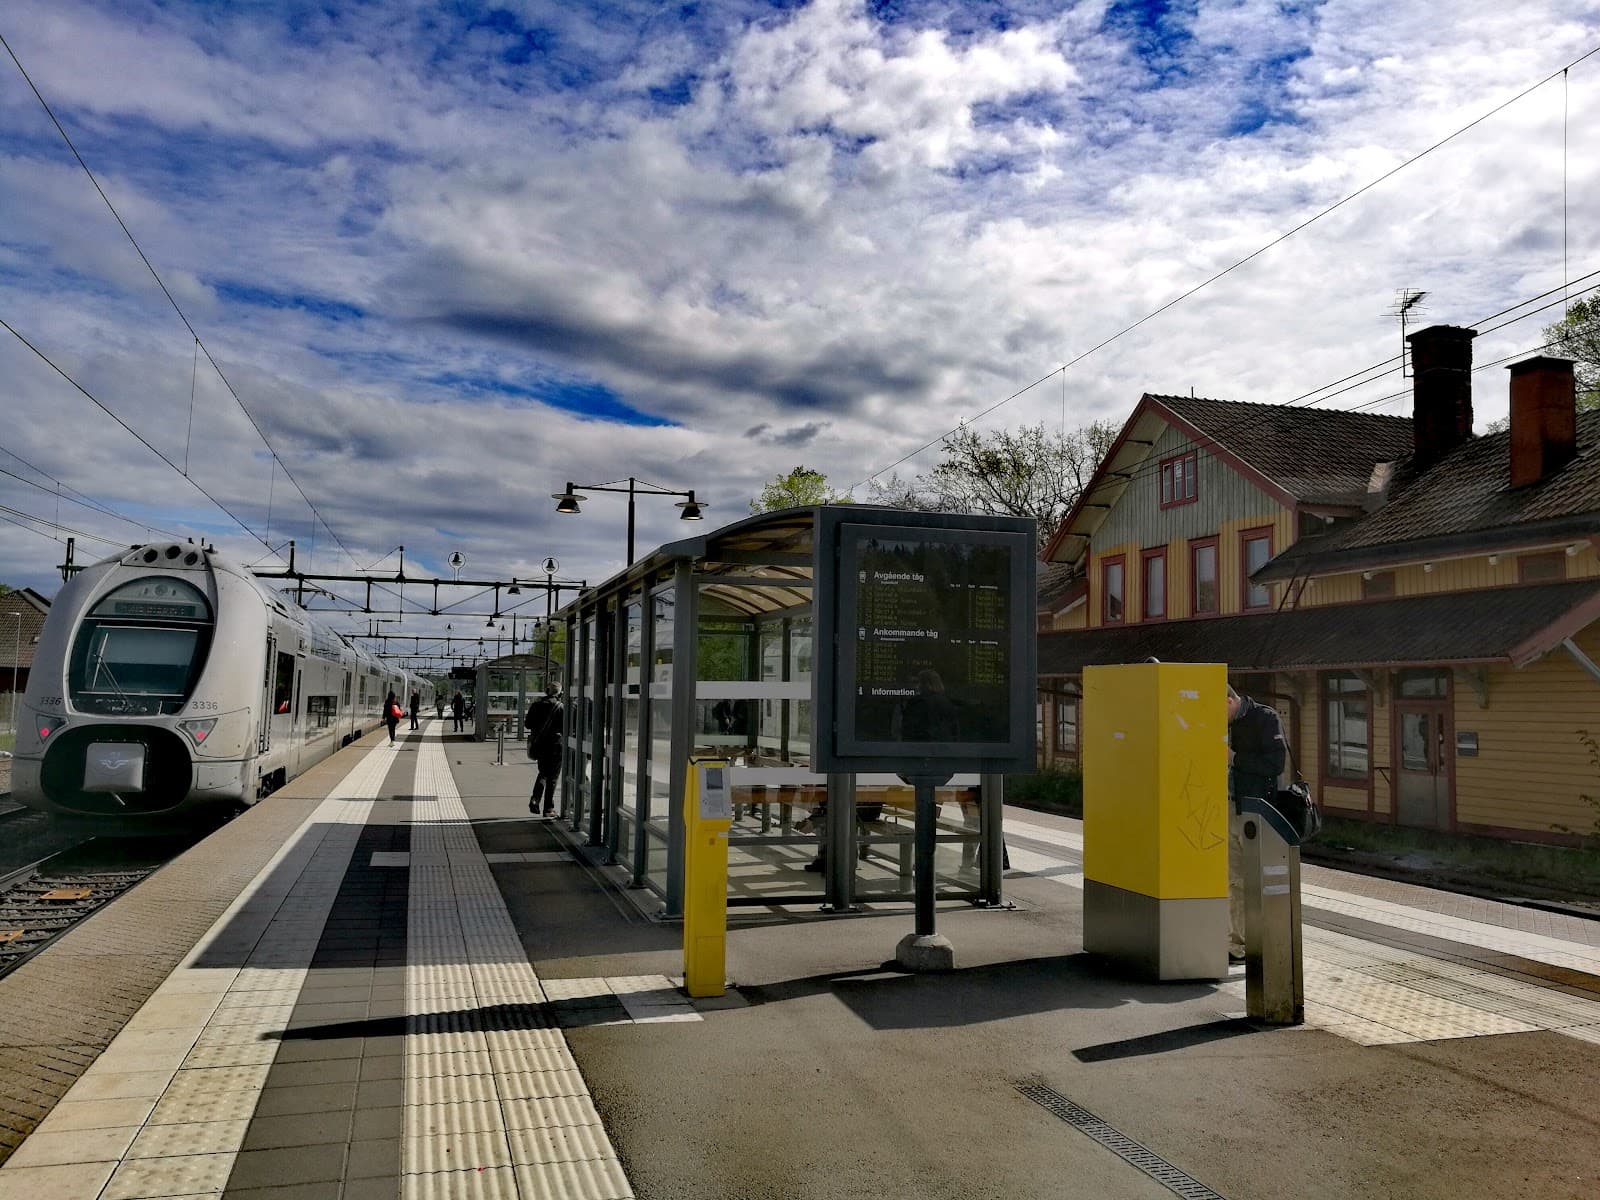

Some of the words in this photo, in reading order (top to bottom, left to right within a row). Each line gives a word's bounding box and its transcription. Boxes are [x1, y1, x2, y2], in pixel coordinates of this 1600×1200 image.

[873, 571, 910, 581] Avgående
[912, 572, 924, 583] tåg
[873, 628, 925, 637] Ankommande
[926, 629, 939, 639] tåg
[871, 687, 915, 696] Information
[191, 700, 218, 711] 3336
